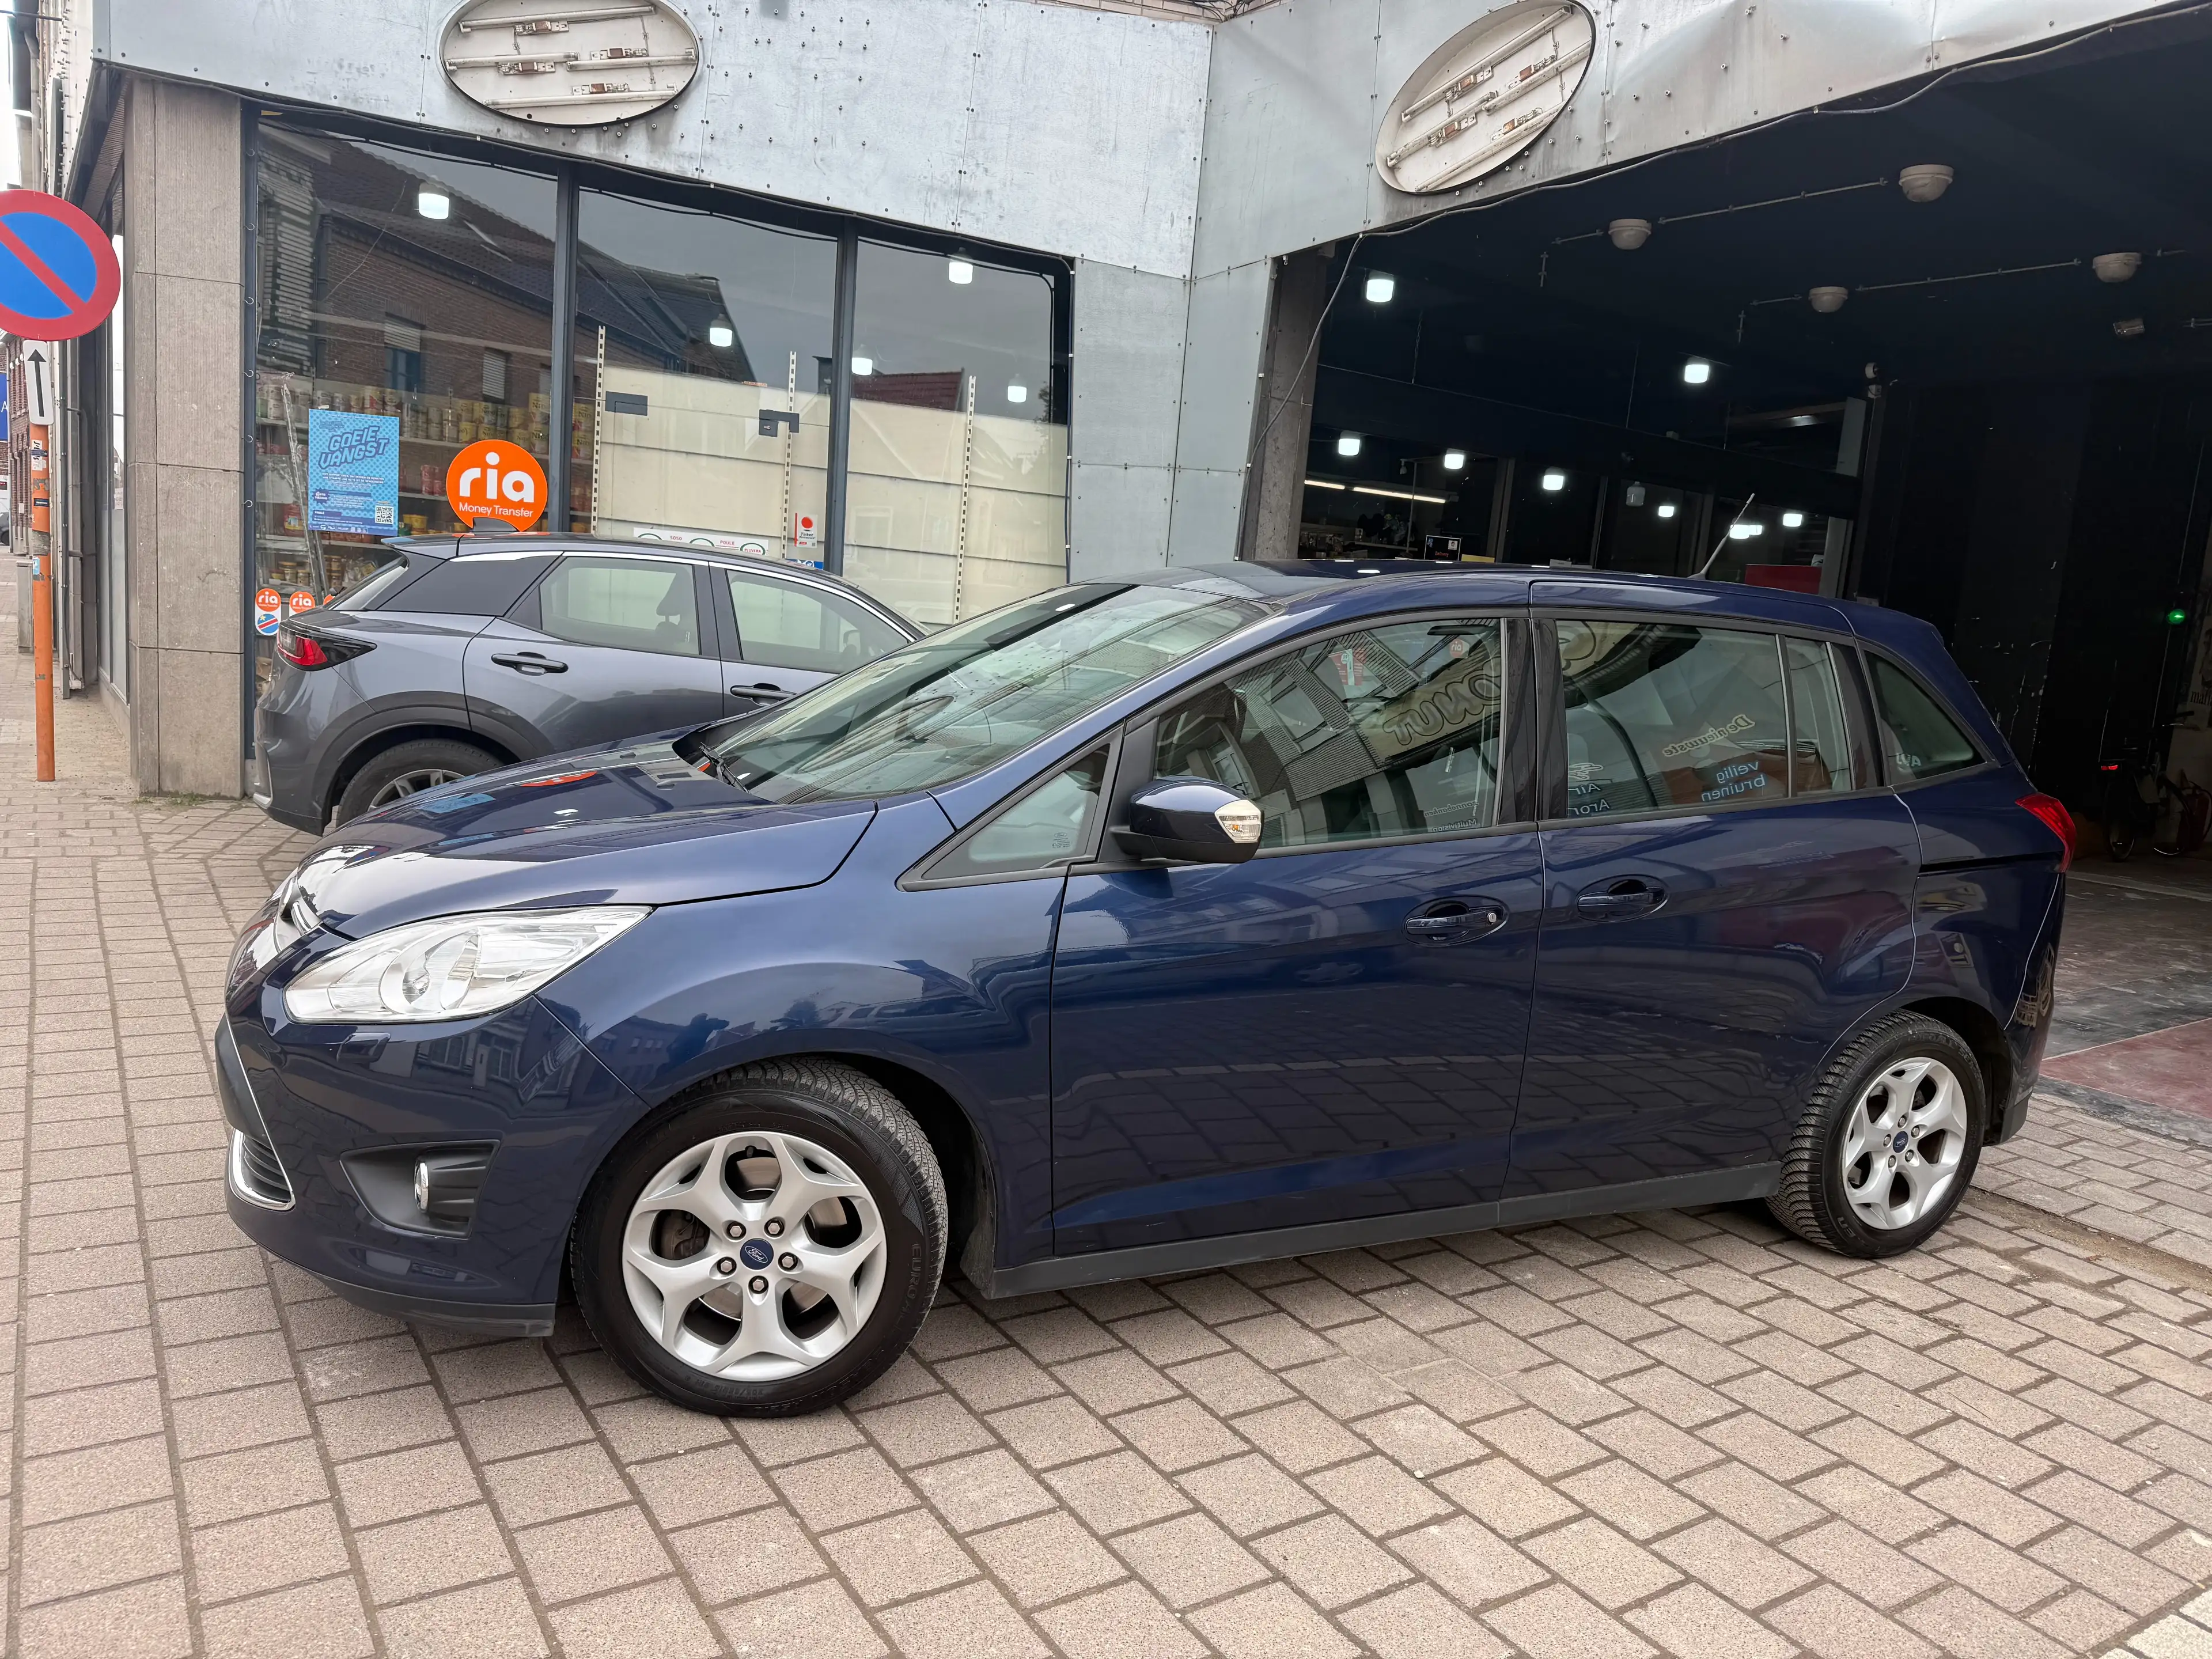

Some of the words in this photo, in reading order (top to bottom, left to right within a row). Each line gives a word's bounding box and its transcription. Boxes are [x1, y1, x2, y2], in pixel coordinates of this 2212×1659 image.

[329, 426, 380, 451] GOEIE
[319, 438, 389, 468] VANGST
[460, 452, 535, 503] ria
[459, 502, 492, 516] Money
[493, 505, 534, 517] Transfer
[258, 591, 278, 604] ria
[292, 594, 312, 607] ria
[748, 1248, 764, 1261] Ford
